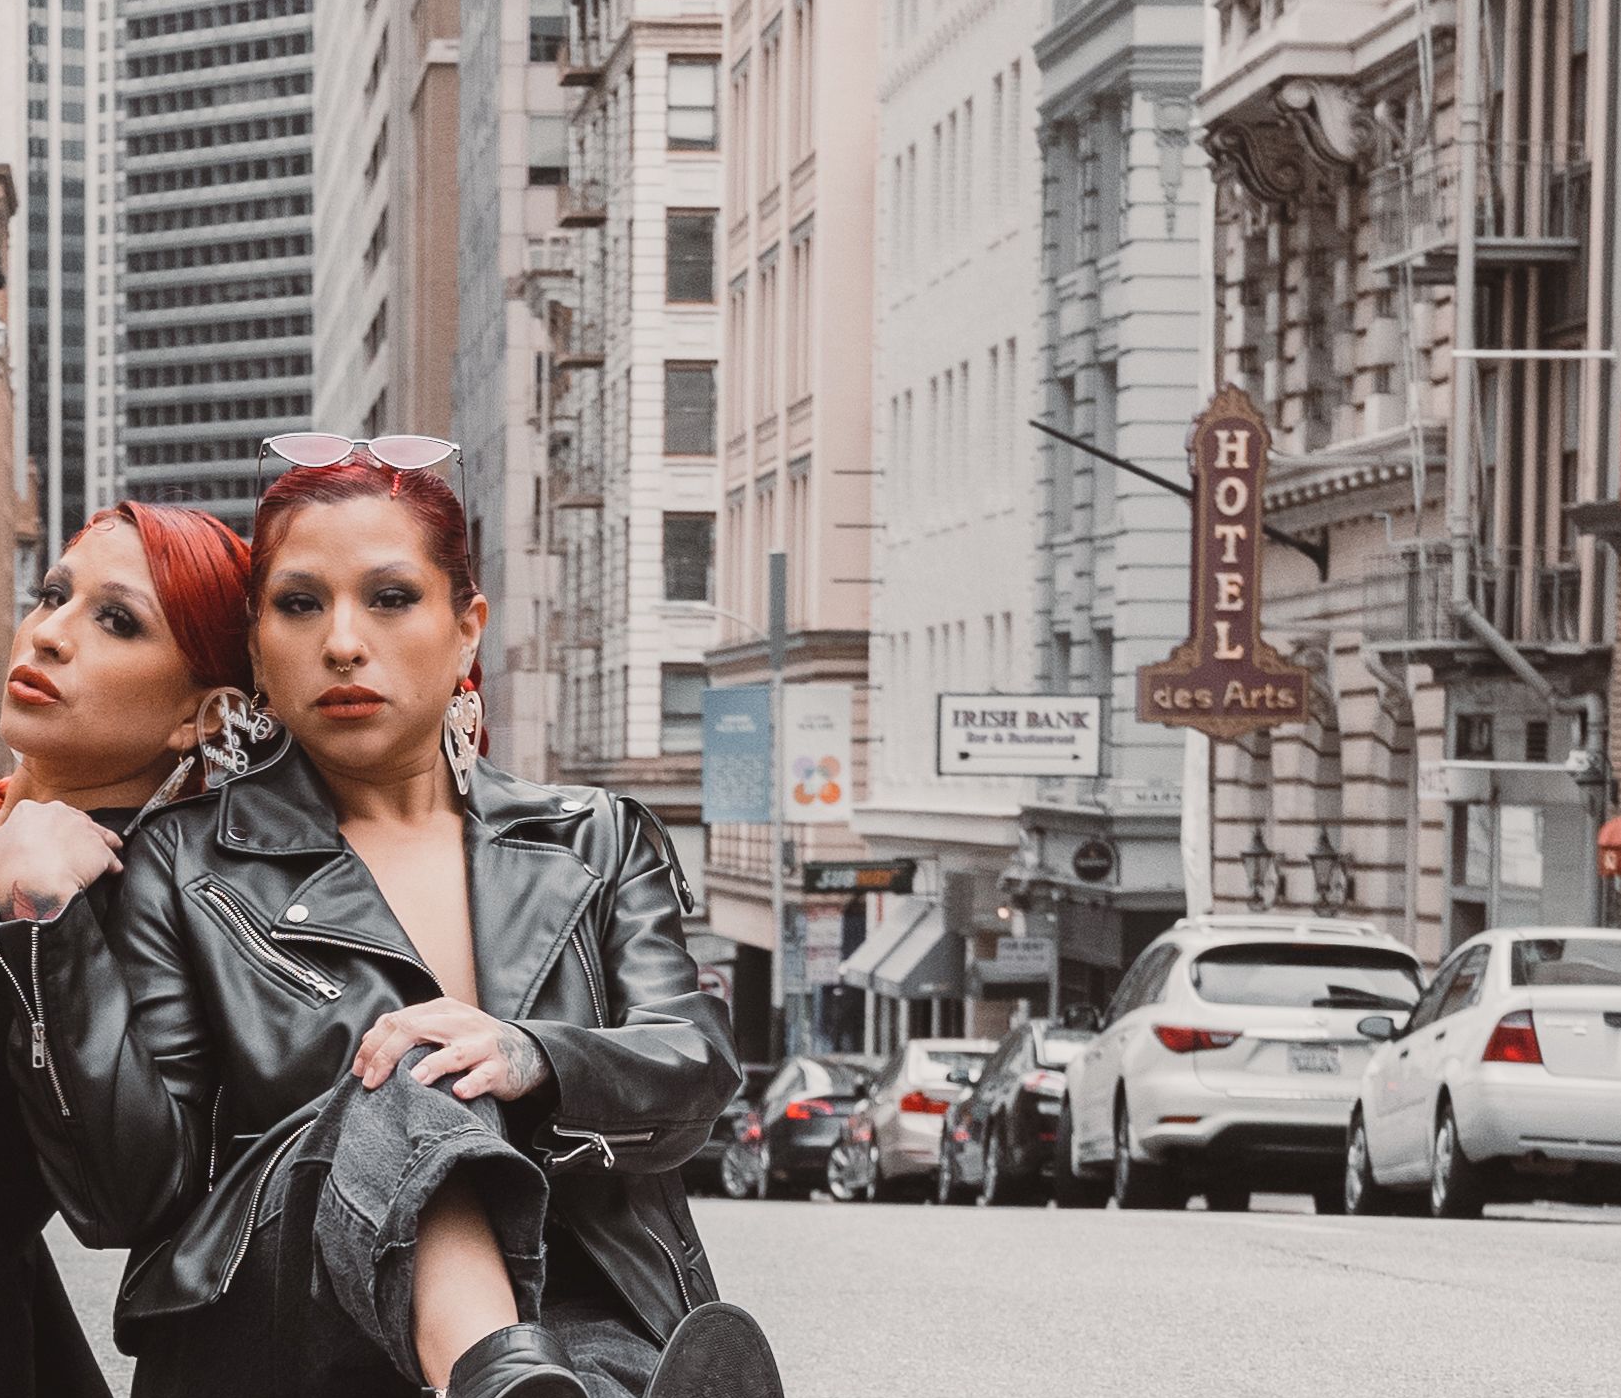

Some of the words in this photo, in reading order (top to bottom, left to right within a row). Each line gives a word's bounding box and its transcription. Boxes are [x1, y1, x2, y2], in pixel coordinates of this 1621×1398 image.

[1213, 429, 1250, 660] HOTEL
[1153, 683, 1213, 709] des
[1223, 679, 1297, 709] Arts
[952, 710, 1018, 728] IRISH
[1026, 711, 1090, 729] BANK
[815, 867, 901, 890] SUBWAY
